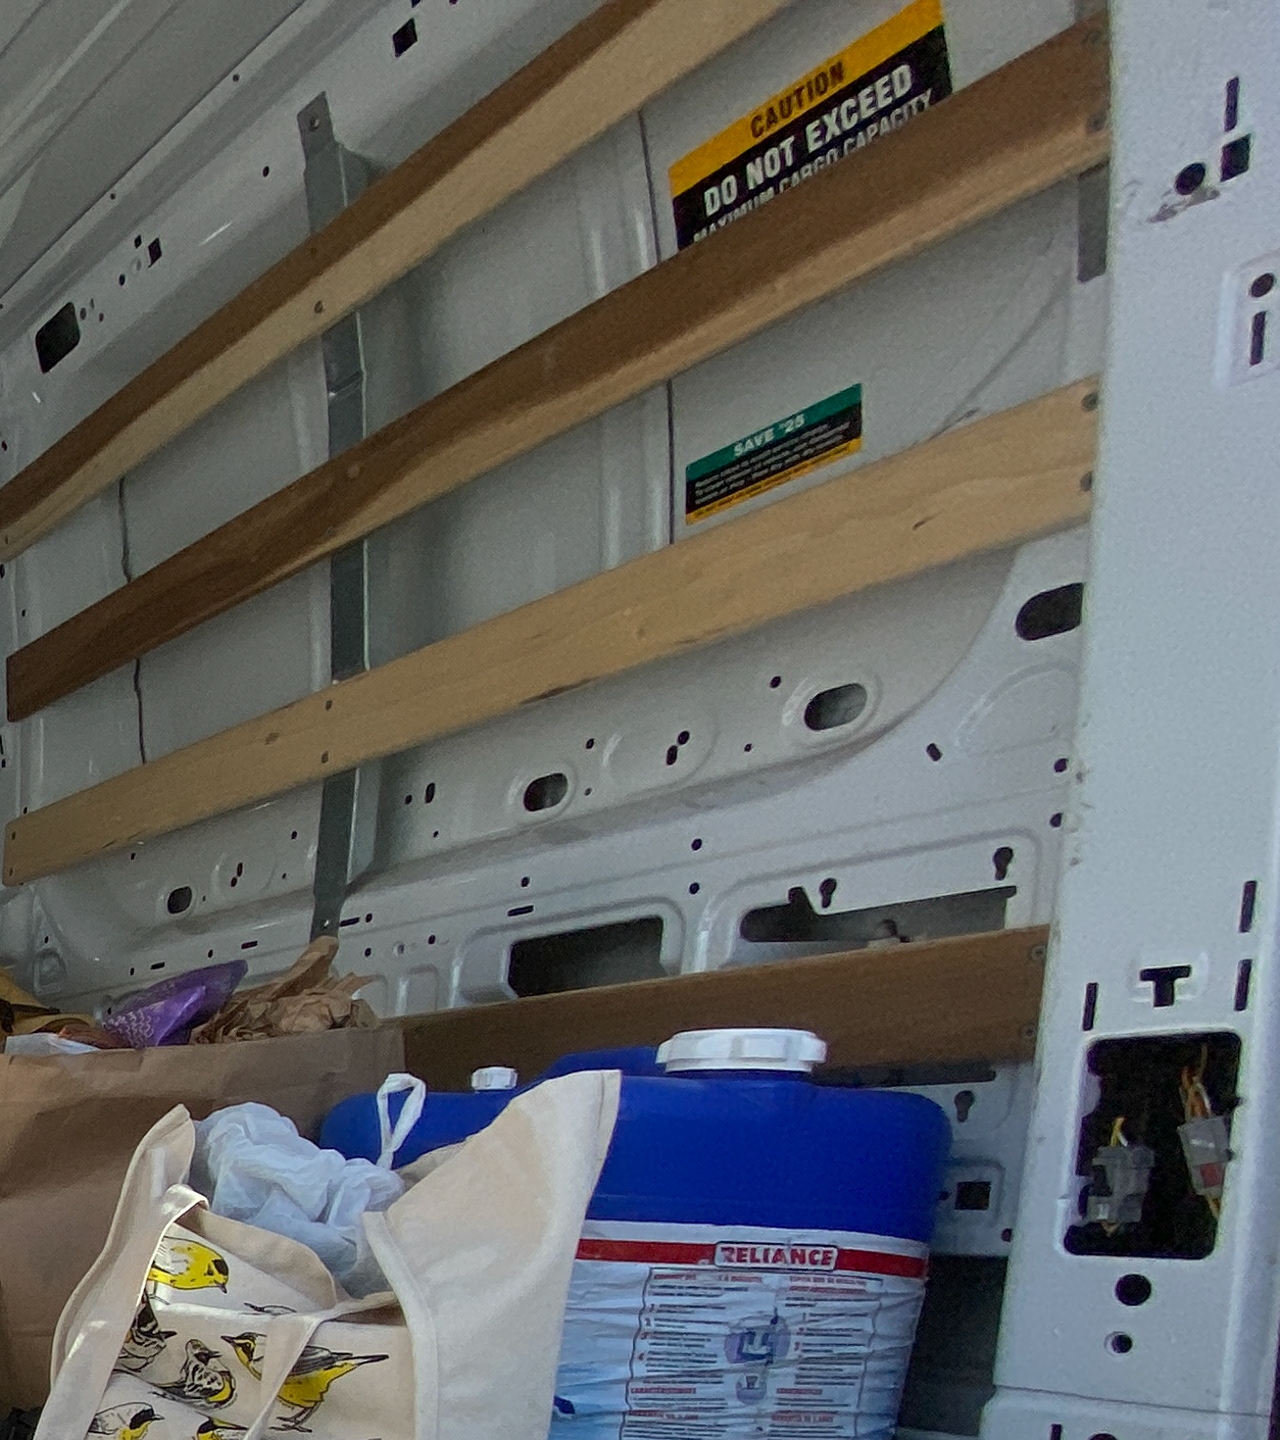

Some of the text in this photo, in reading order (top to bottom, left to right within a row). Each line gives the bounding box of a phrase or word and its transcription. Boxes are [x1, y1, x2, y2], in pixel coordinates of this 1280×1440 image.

[749, 60, 846, 139] CAUTION
[703, 63, 913, 217] DO NOT EXCEED
[734, 427, 776, 458] SAVE
[720, 1245, 835, 1266] RELIANCE
